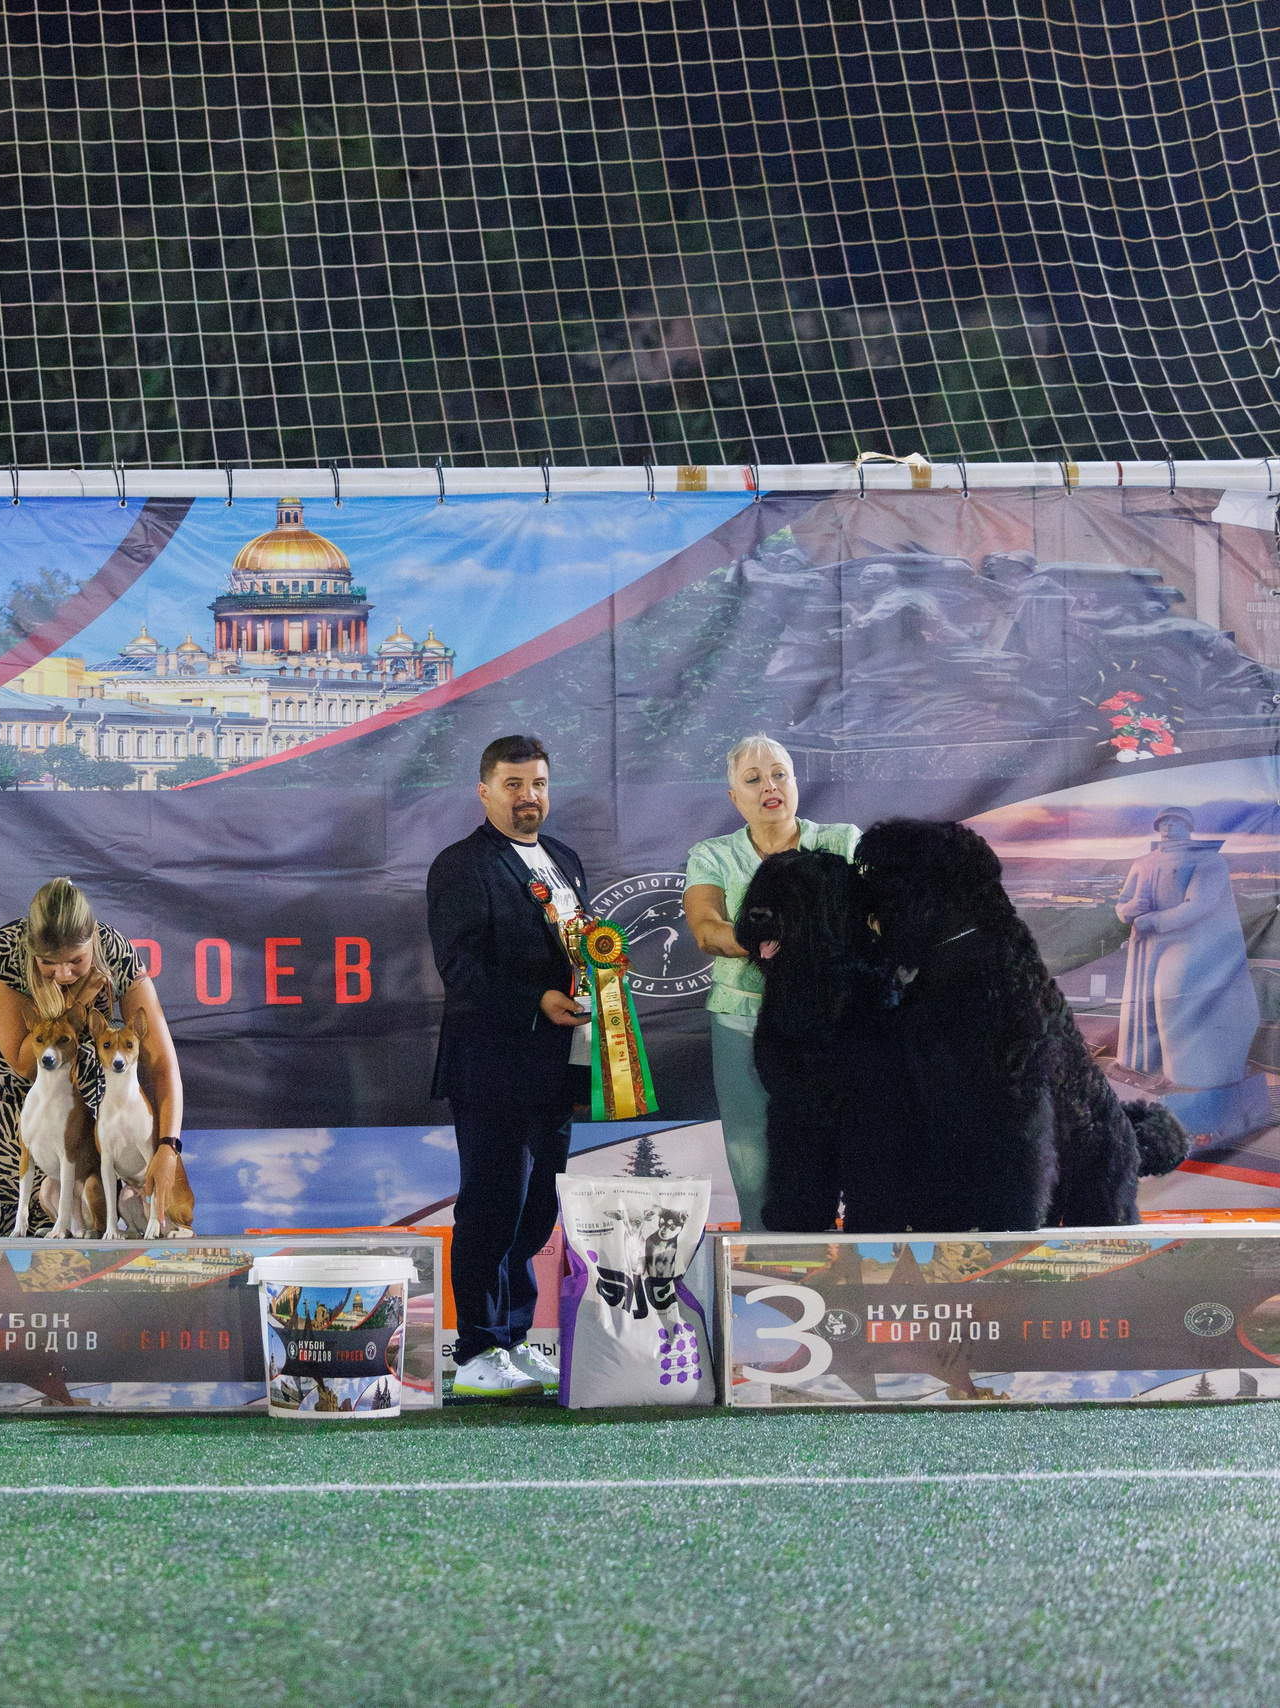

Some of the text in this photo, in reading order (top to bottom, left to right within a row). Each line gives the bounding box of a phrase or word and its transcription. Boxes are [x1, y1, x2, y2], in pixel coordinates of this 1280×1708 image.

[593, 877, 686, 915] КИНОЛОГИ
[129, 936, 372, 1006] РОЕВ
[867, 1303, 974, 1320] КУБОК
[742, 1284, 834, 1384] 3
[871, 1319, 1131, 1343] ГОРОДОВ ГЕРОЕВ
[298, 1340, 325, 1350] КУБОК
[300, 1350, 332, 1362] ГОРОДОВ
